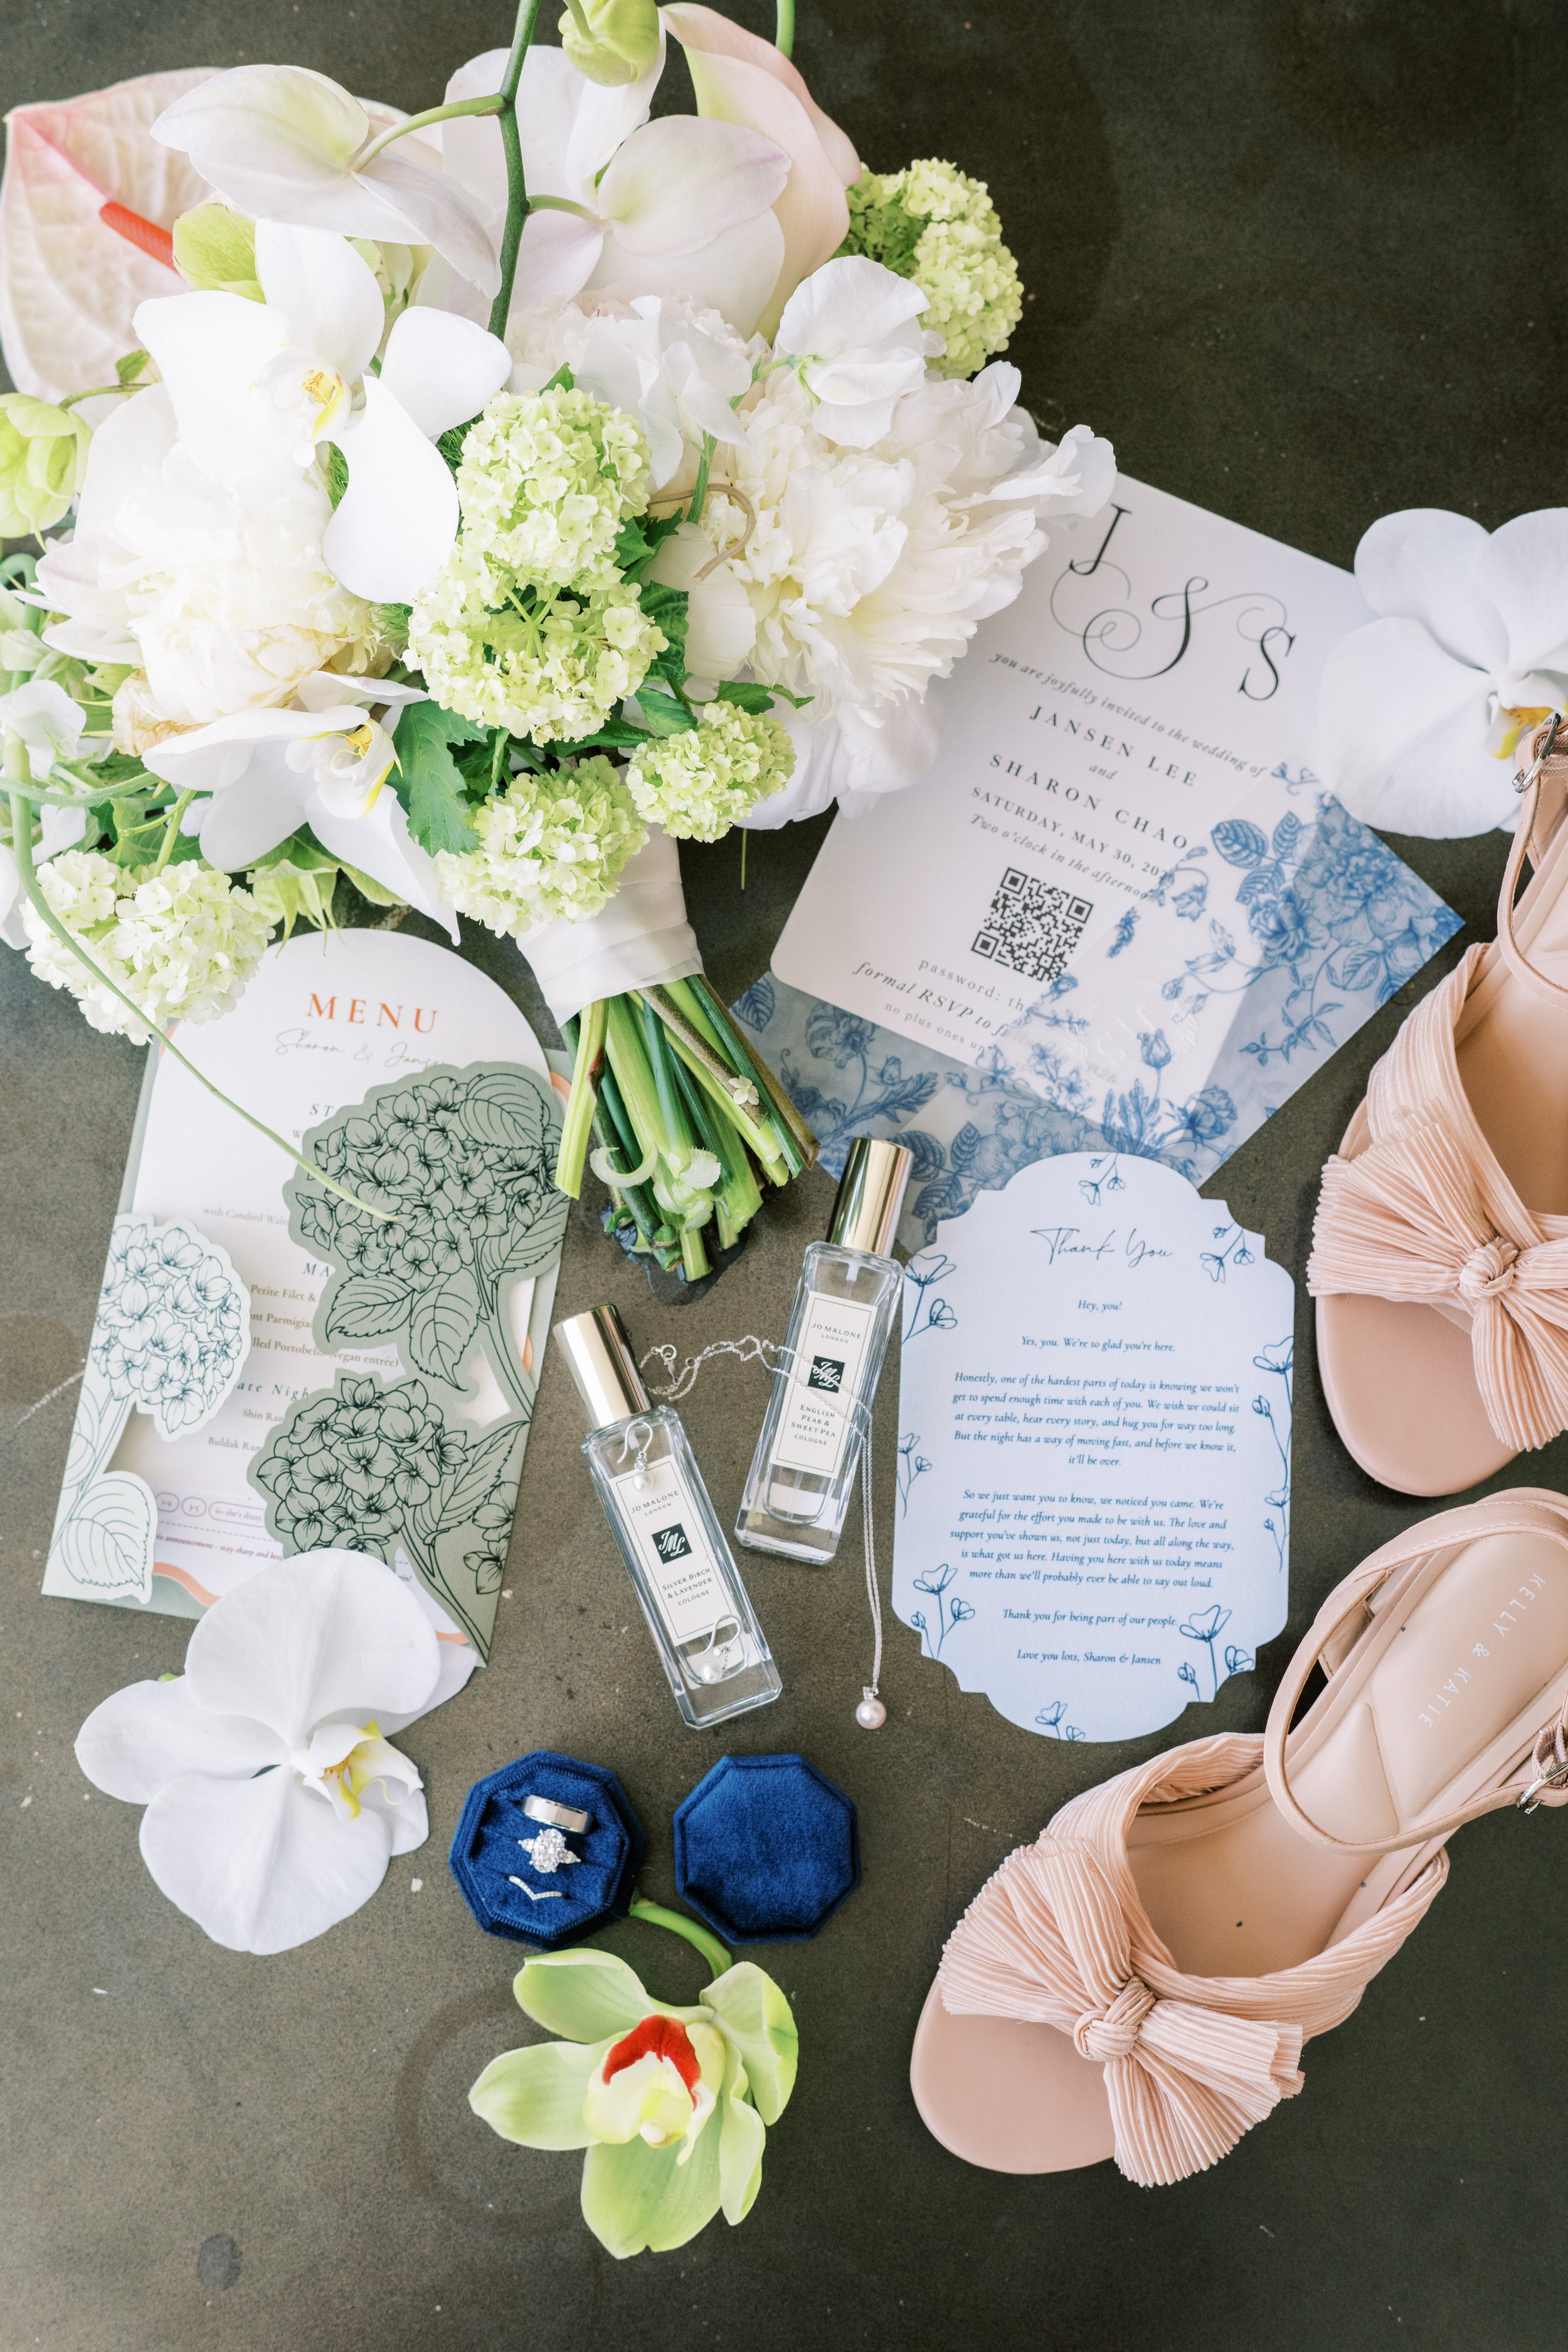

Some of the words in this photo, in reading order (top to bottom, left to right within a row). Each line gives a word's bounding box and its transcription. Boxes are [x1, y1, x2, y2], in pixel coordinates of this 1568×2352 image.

[1069, 503, 1132, 575] J
[1237, 626, 1297, 701] S
[988, 653, 1017, 667] you
[1020, 666, 1043, 679] are
[1040, 673, 1098, 704] joyfully
[1100, 697, 1152, 724] invited
[1151, 721, 1164, 731] to
[1167, 728, 1189, 743] the
[1193, 740, 1248, 771] wedding
[1250, 766, 1267, 777] of
[1029, 706, 1134, 757] JANSEN
[1148, 756, 1196, 786] LEE
[1089, 766, 1118, 780] and
[990, 755, 1100, 810] SHARON
[1115, 810, 1187, 850] CHAO
[970, 813, 999, 833] Two
[1002, 831, 1047, 855] o'clock
[1050, 849, 1066, 862] in
[1067, 859, 1089, 873] the
[972, 787, 1064, 837] SATURDAY,
[1074, 830, 1109, 853] MAY
[1113, 850, 1134, 867] 30,
[1142, 862, 1175, 883] 202
[918, 960, 1000, 1000] password:
[852, 962, 916, 993] formal
[918, 988, 973, 1017] RSVP
[975, 1016, 991, 1028] to
[307, 993, 438, 1032] MENU
[884, 1004, 900, 1014] no
[904, 1012, 931, 1028] plus
[936, 1027, 964, 1043] ones
[275, 1027, 345, 1055] Sharon
[352, 1044, 373, 1062] &
[203, 1206, 223, 1216] with
[225, 1209, 263, 1222] Candied
[1030, 1227, 1116, 1265] Thank
[1125, 1227, 1173, 1268] You
[250, 1285, 279, 1296] Petite
[282, 1288, 304, 1300] Filet
[307, 1293, 315, 1302] &
[1078, 1300, 1098, 1312] Hey,
[1101, 1301, 1122, 1313] you!
[820, 1333, 849, 1343] LONDON
[824, 1325, 861, 1339] MALONE
[1022, 1335, 1037, 1347] Yes,
[1039, 1340, 1059, 1349] you.
[1063, 1338, 1088, 1348] We're
[1101, 1338, 1123, 1352] glad
[1123, 1341, 1152, 1352] you're
[1154, 1340, 1175, 1351] here.
[955, 1372, 997, 1385] Honestly,
[1019, 1374, 1030, 1387] of
[1030, 1374, 1045, 1384] the
[1047, 1375, 1081, 1385] hardest
[1083, 1380, 1106, 1389] parts
[1109, 1377, 1120, 1391] of
[1120, 1378, 1147, 1392] today
[1149, 1380, 1156, 1389] is
[1159, 1379, 1197, 1394] knowing
[1215, 1384, 1239, 1393] won't
[800, 1404, 835, 1417] ENGLISH
[951, 1394, 966, 1404] get
[980, 1392, 1007, 1405] spend
[1008, 1394, 1041, 1407] enough
[1067, 1395, 1087, 1406] with
[1089, 1396, 1110, 1406] each
[1113, 1397, 1123, 1411] of
[1123, 1402, 1143, 1411] you.
[1147, 1399, 1161, 1409] We
[1163, 1400, 1184, 1409] wish
[1202, 1401, 1227, 1412] could
[242, 1409, 263, 1419] Shin
[801, 1414, 822, 1424] PEAR
[791, 1421, 818, 1433] SWEET
[820, 1428, 835, 1438] PEA
[208, 1436, 239, 1449] Buldak
[794, 1434, 827, 1446] COLOGNE
[1068, 1454, 1084, 1464] it'll
[1087, 1454, 1098, 1465] be
[632, 1505, 641, 1513] JO
[642, 1490, 679, 1508] MALONE
[644, 1502, 671, 1516] LONDON
[662, 1577, 687, 1591] SILVER
[688, 1567, 711, 1580] BIRCH
[674, 1577, 712, 1596] LAVENDER
[995, 1568, 1016, 1579] than
[1019, 1570, 1041, 1580] we'll
[1042, 1571, 1084, 1586] probably
[1108, 1572, 1118, 1584] be
[1120, 1574, 1140, 1584] able
[1155, 1579, 1170, 1589] say
[1190, 1576, 1212, 1587] loud.
[677, 1589, 709, 1606] COLOGNE
[1493, 1572, 1546, 1638] KELLY
[1003, 1608, 1031, 1619] Thank
[1032, 1613, 1051, 1623] you
[1051, 1610, 1067, 1624] for
[1069, 1611, 1094, 1625] being
[1095, 1616, 1115, 1626] part
[1118, 1613, 1129, 1626] of
[1147, 1615, 1178, 1628] people.
[1017, 1649, 1039, 1660] Love
[1040, 1653, 1058, 1663] you
[1061, 1650, 1080, 1662] lots,
[1083, 1651, 1116, 1662] Sharon
[1119, 1653, 1129, 1663] &
[1130, 1653, 1160, 1665] Jansen
[1473, 1642, 1491, 1658] &
[1418, 1666, 1472, 1728] KATIE
